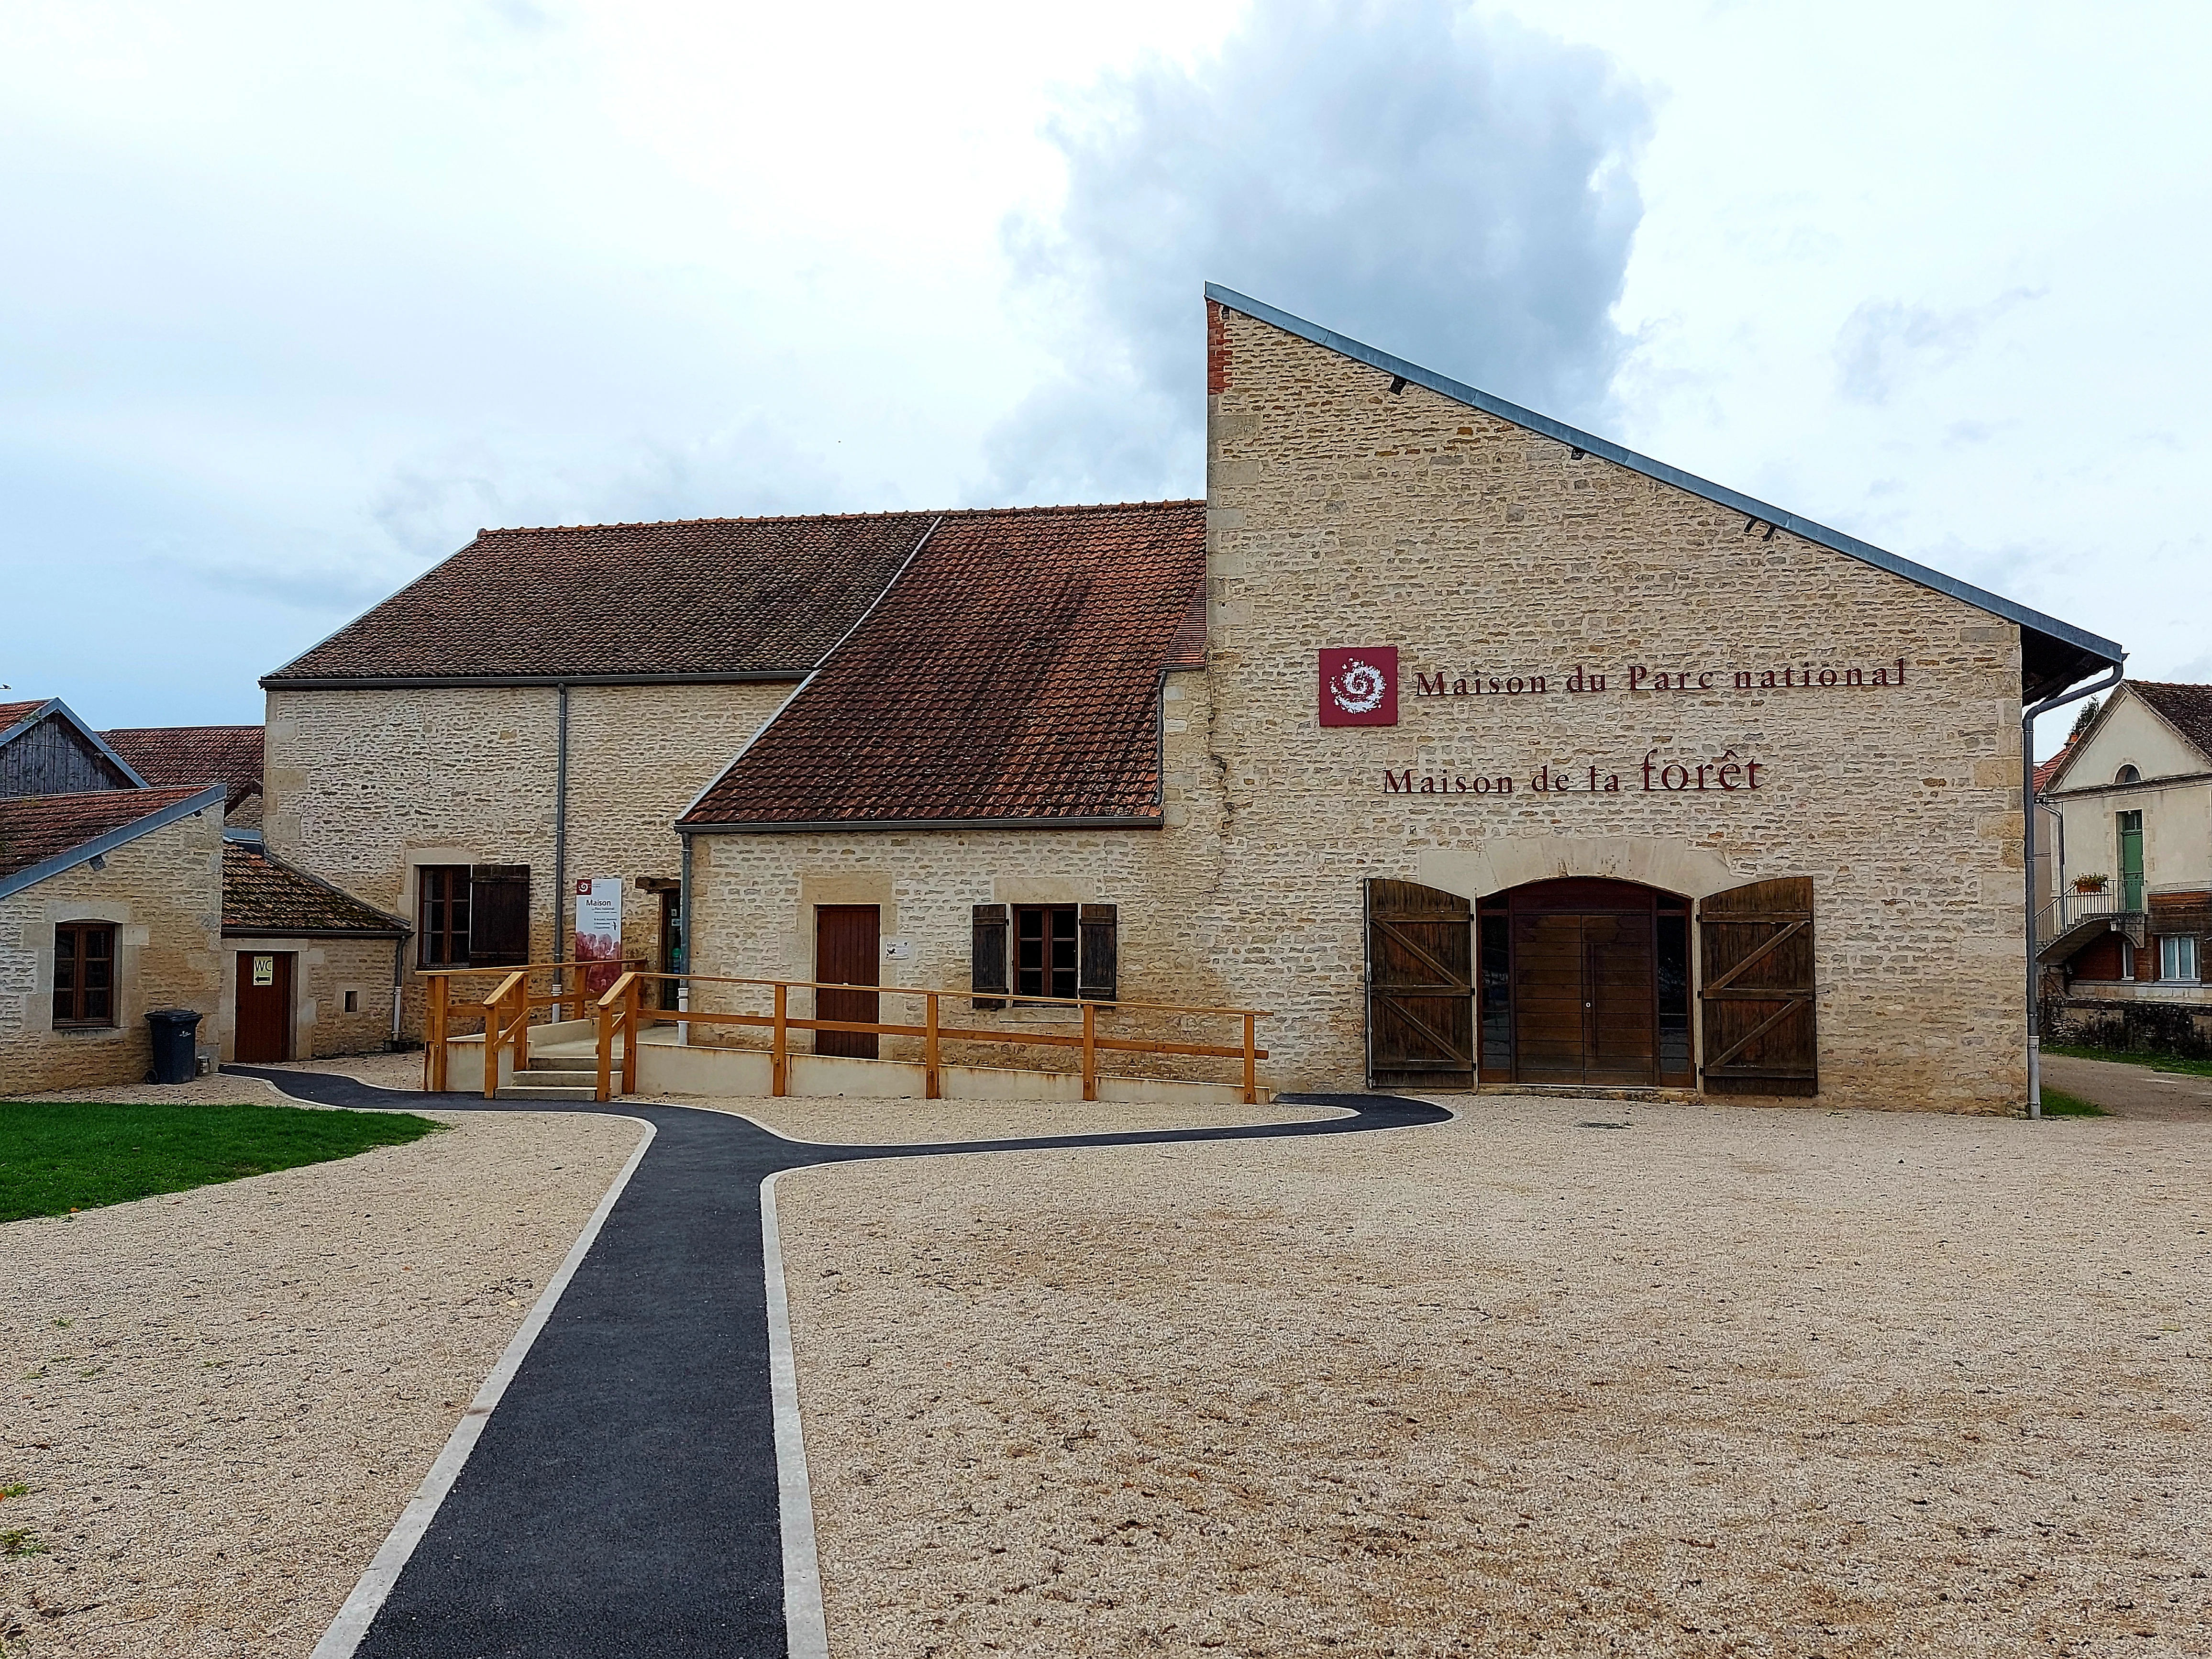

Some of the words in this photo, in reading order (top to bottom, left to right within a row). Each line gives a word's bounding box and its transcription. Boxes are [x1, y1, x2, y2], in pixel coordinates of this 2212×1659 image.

[1414, 670, 1548, 697] Maison
[1567, 666, 1608, 693] du
[1627, 665, 1714, 691] Parc
[1734, 657, 1906, 689] national
[1382, 768, 1515, 794] Maison
[1531, 764, 1570, 792] de
[1588, 764, 1620, 792] la
[1640, 749, 1763, 792] forêt
[254, 960, 272, 972] WC
